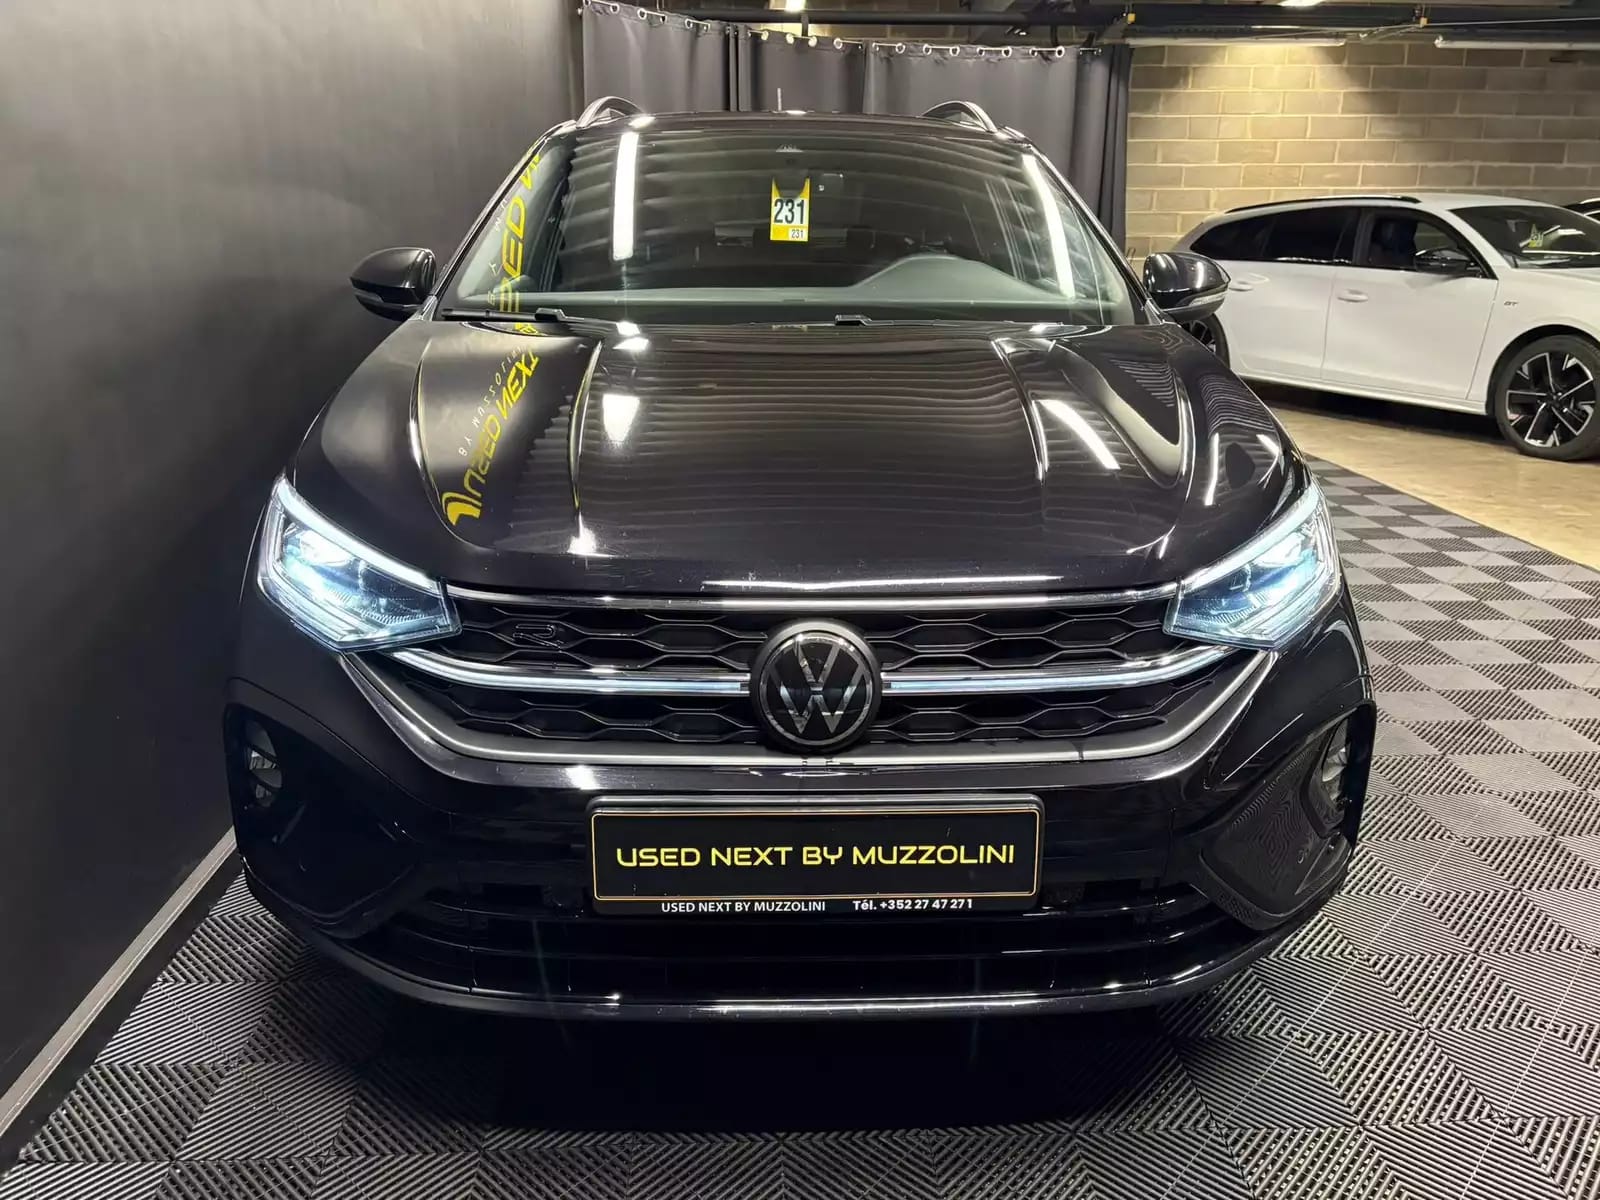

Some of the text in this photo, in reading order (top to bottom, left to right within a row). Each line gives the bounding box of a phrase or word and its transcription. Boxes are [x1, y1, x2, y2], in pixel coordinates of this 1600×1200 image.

[773, 198, 805, 224] 231
[791, 229, 804, 239] 231
[616, 844, 1015, 867] USED NEXT BY MUZZOLINI
[661, 901, 826, 913] USED NEXT BY MUZZOLINI
[852, 898, 973, 911] Tél. +352 27 47 271
